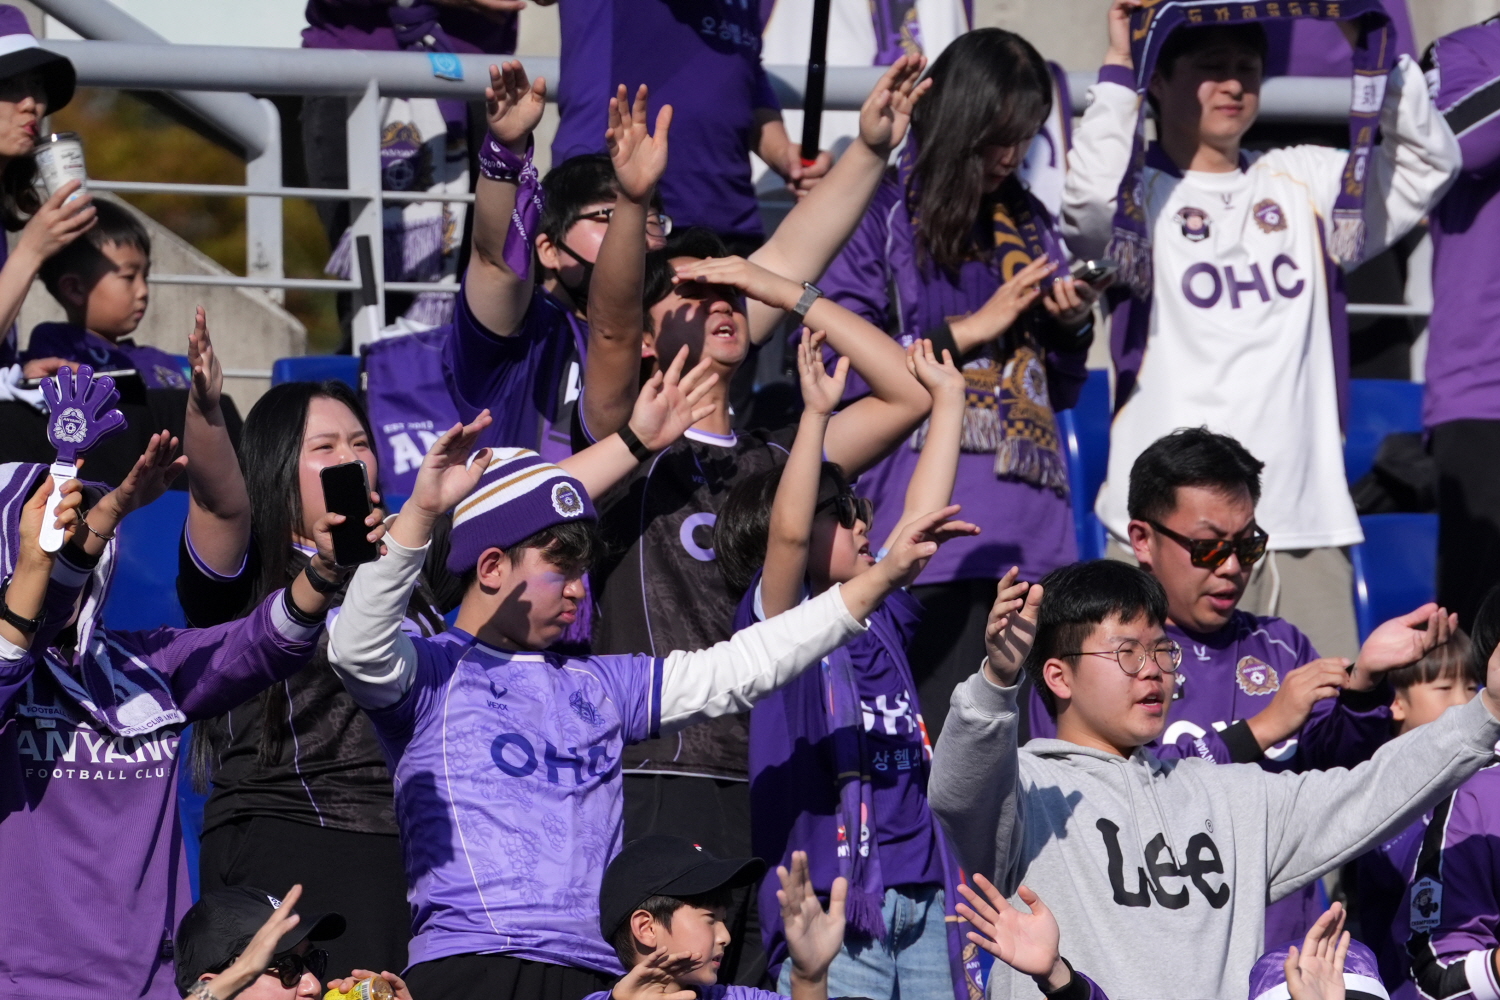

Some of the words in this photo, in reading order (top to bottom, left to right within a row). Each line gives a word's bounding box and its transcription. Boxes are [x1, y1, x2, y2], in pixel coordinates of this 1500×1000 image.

[1181, 253, 1305, 309] OHC
[487, 700, 509, 711] VEXX
[26, 769, 127, 780] FOOTBALL
[491, 733, 622, 784] OHC
[1096, 818, 1230, 910] Lee
